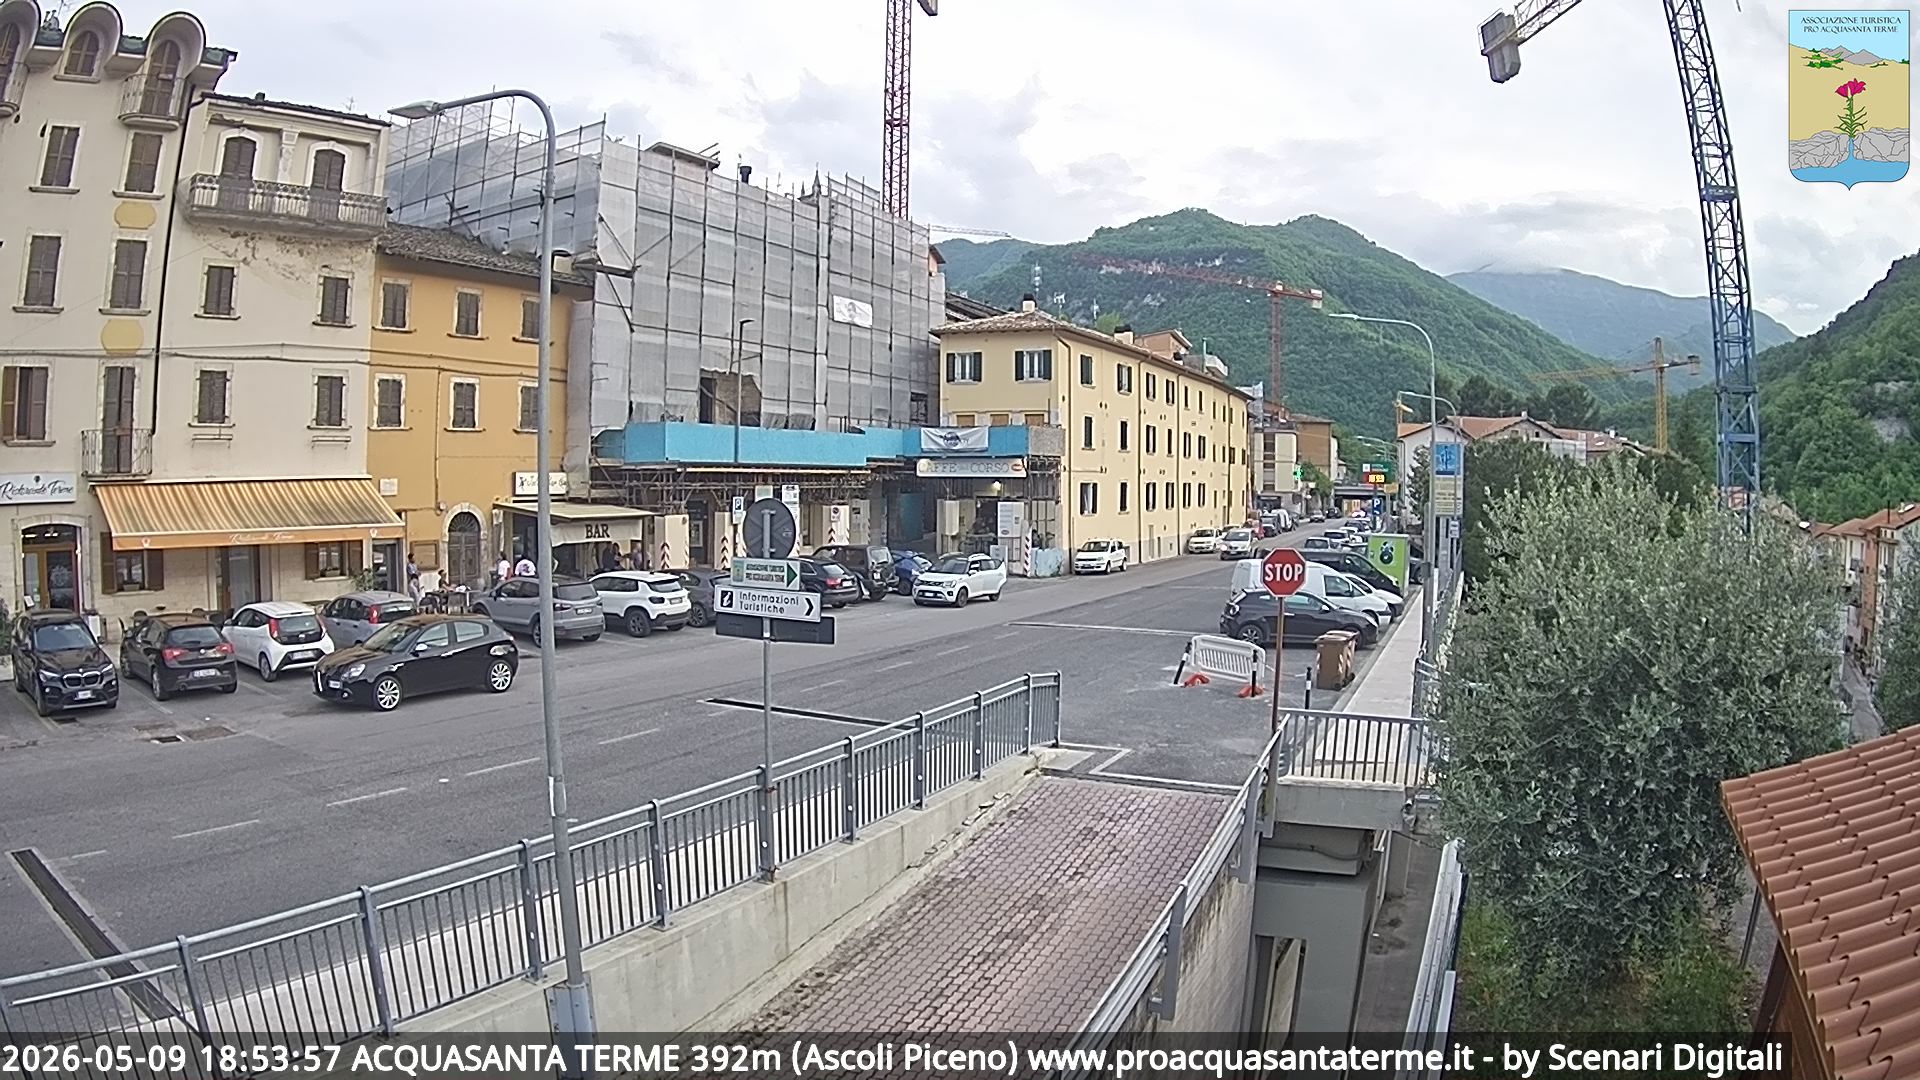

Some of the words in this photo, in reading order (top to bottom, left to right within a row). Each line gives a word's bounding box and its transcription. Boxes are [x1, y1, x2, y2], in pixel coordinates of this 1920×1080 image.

[970, 461, 1010, 473] CORSO
[1373, 498, 1381, 508] P
[585, 524, 611, 539] BAR
[1264, 563, 1304, 582] STOP
[739, 591, 799, 606] Informazioni
[739, 601, 785, 614] Turistiche
